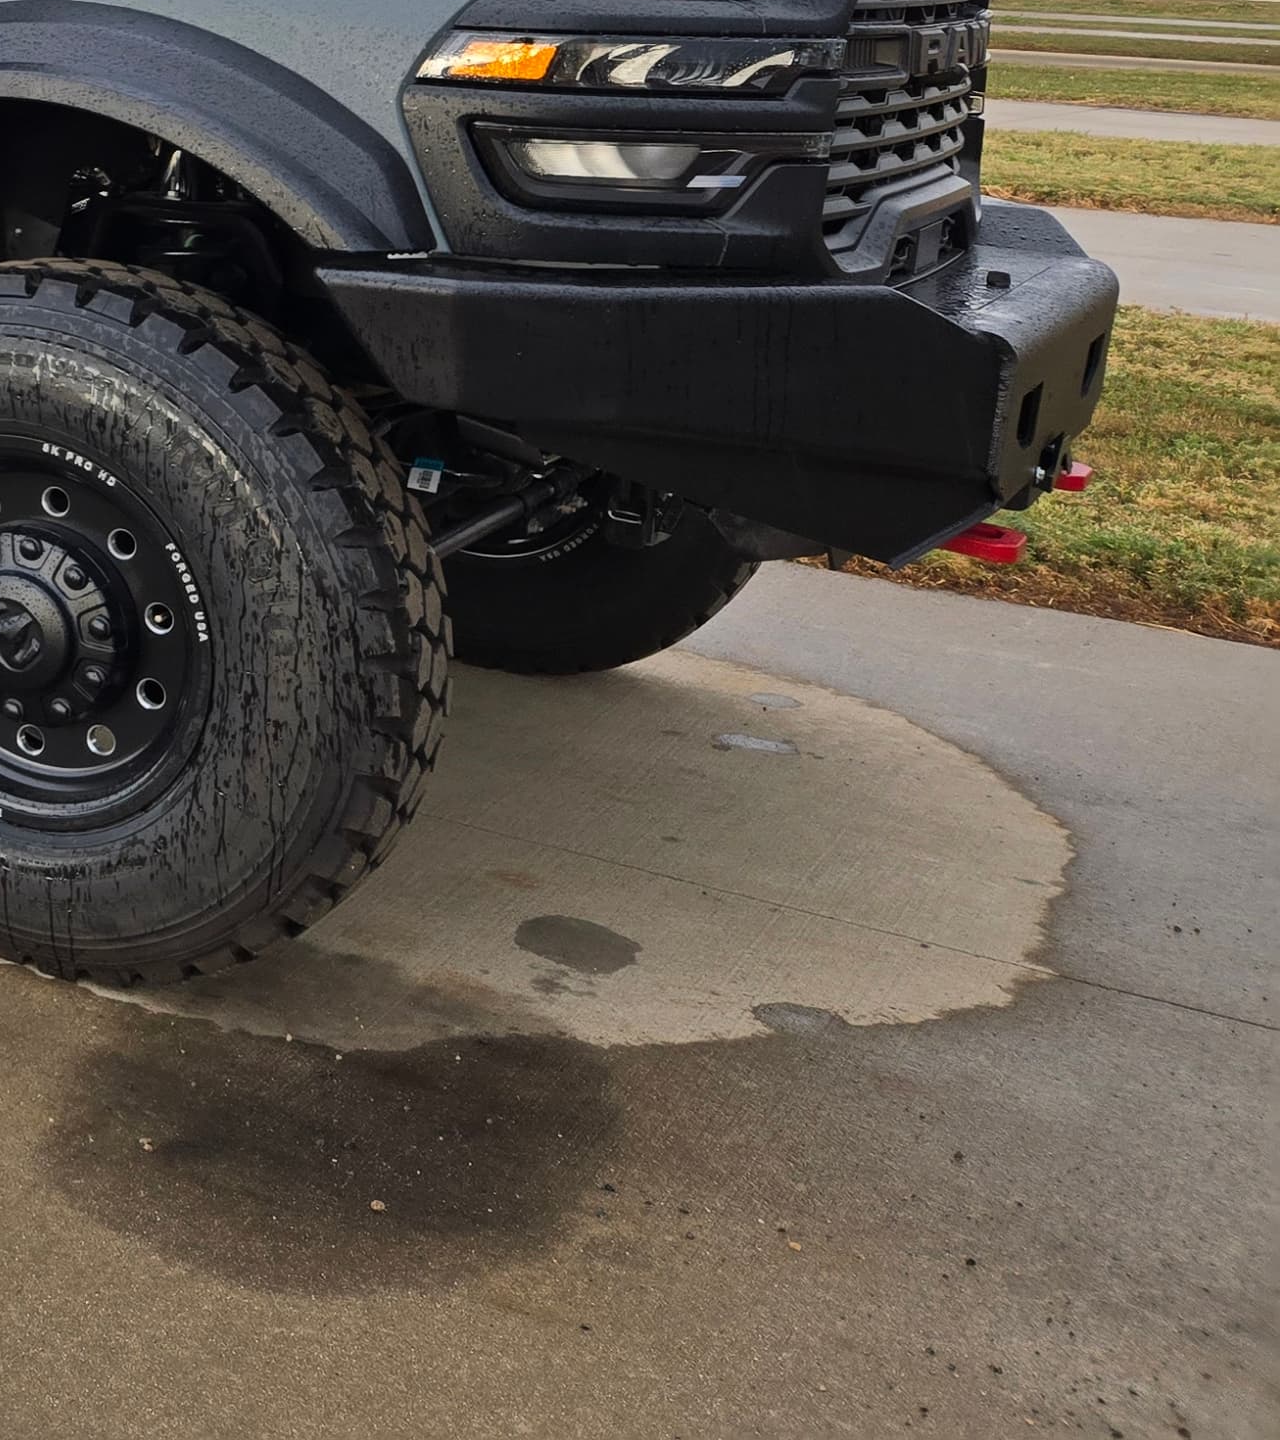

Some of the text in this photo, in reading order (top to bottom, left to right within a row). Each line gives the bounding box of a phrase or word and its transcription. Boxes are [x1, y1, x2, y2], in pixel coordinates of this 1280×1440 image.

[912, 20, 990, 77] RAM
[65, 451, 93, 471] PRO
[98, 469, 117, 487] HD
[165, 543, 208, 642] FORGED USA
